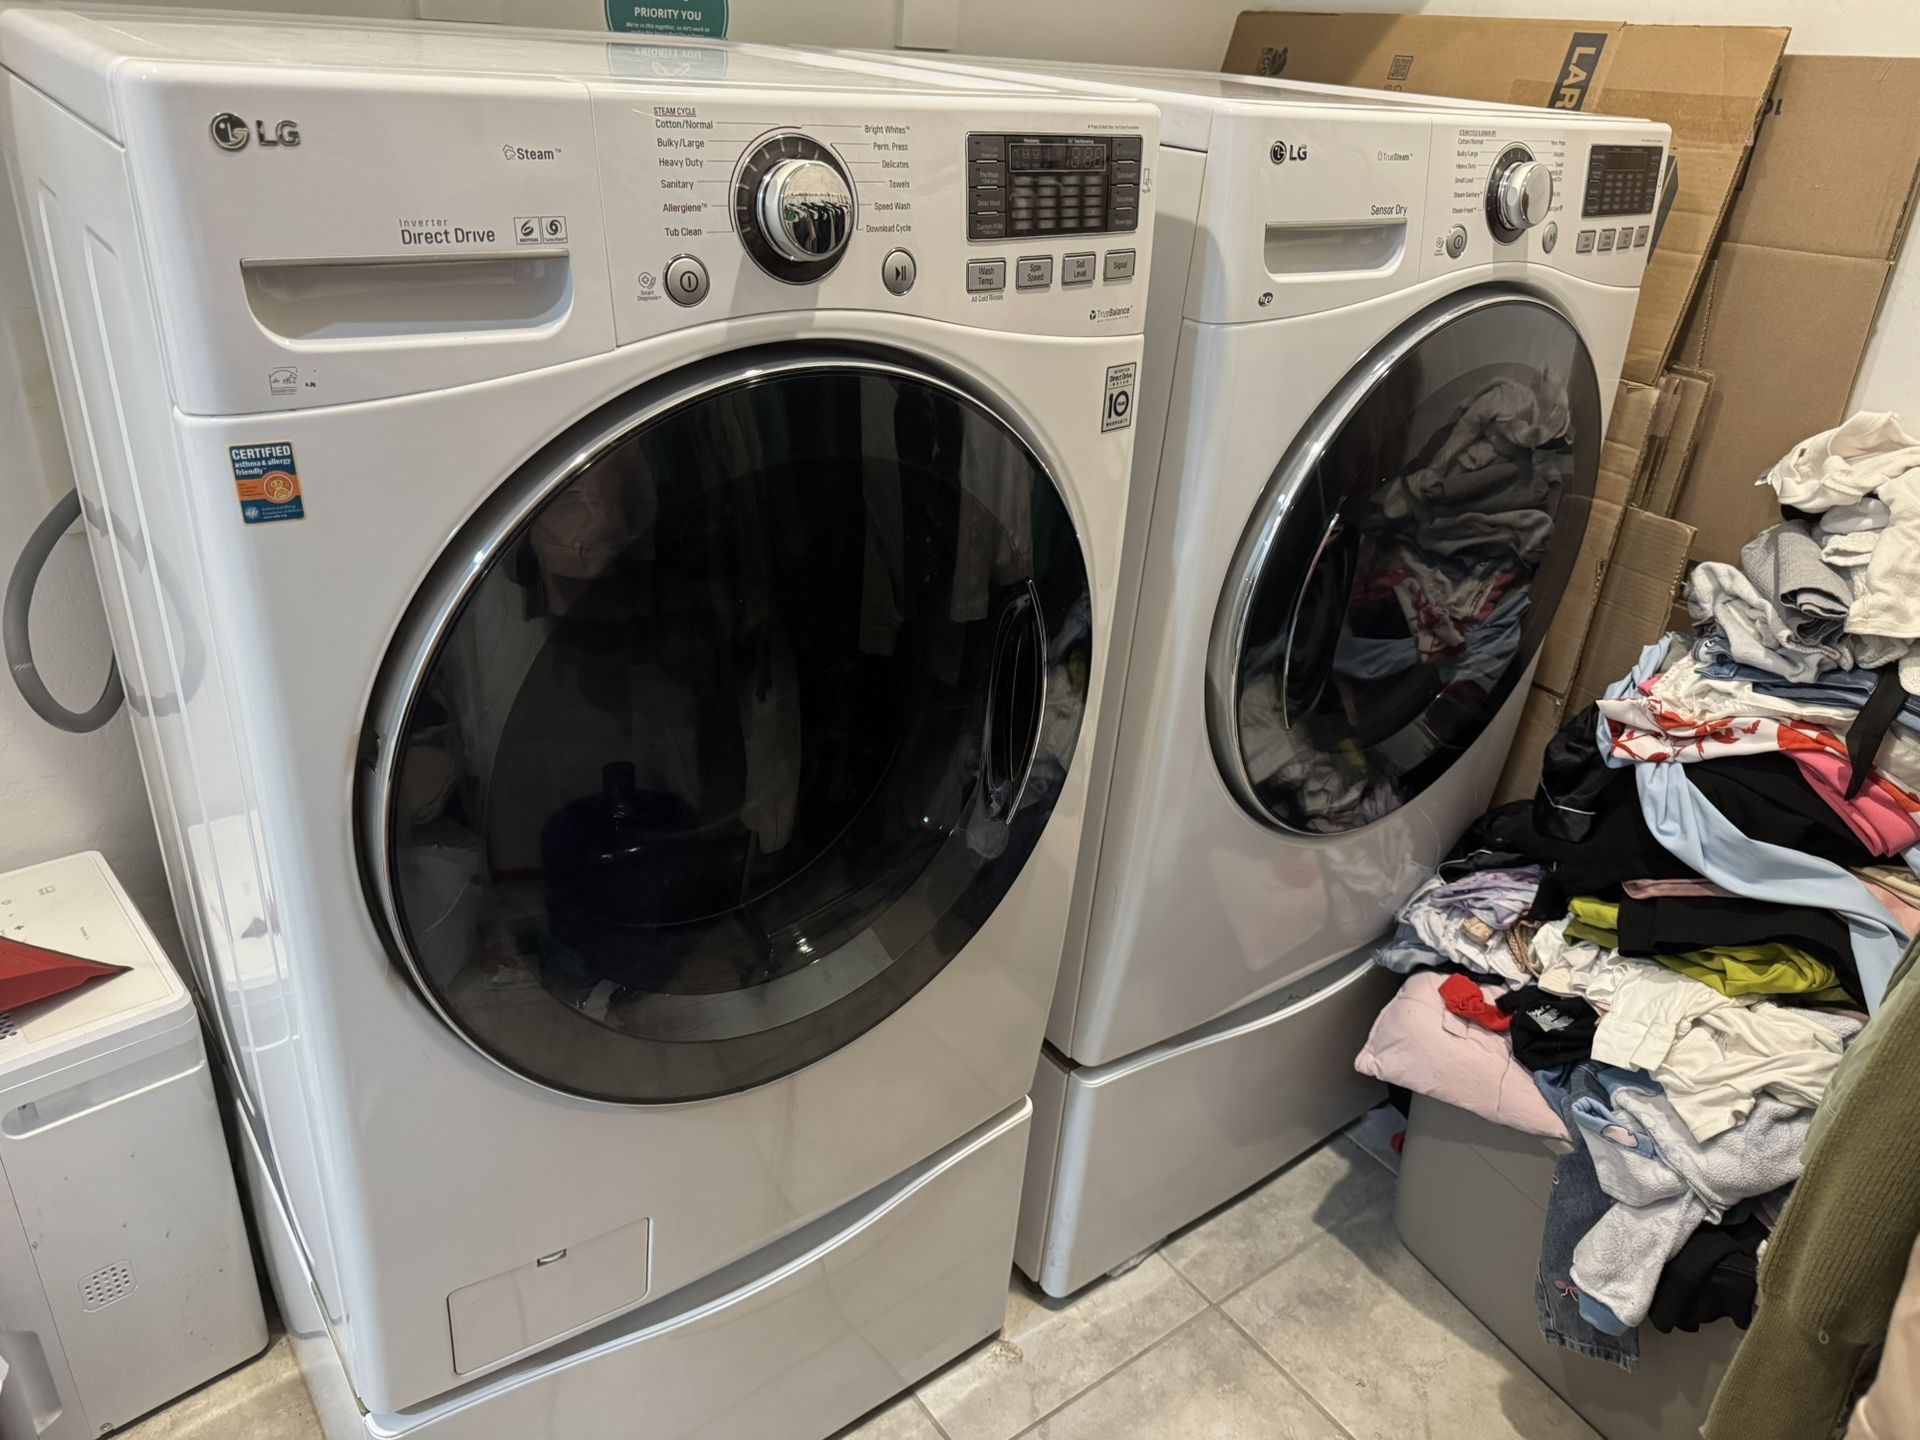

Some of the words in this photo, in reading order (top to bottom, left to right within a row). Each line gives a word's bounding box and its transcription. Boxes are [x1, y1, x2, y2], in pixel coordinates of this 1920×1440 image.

[634, 6, 679, 19] PRIORITY
[681, 10, 702, 21] YOU
[653, 107, 675, 116] STEAM
[677, 107, 696, 116] CYCLE
[655, 119, 714, 130] Cotton/Normal
[864, 124, 884, 135] Bright
[256, 119, 301, 147] LG
[657, 138, 705, 150] Bulky/Large
[892, 142, 908, 152] Press
[1289, 144, 1308, 161] LG
[659, 158, 684, 168] Heavy
[685, 158, 704, 168] Duty
[882, 160, 910, 169] Delicates
[660, 180, 694, 190] Sanitary
[888, 180, 910, 189] Towels
[874, 202, 894, 212] Speed
[894, 202, 911, 210] Wash
[1370, 204, 1394, 216] Sensor
[1396, 204, 1408, 216] Dry
[398, 218, 448, 228] Inverter
[664, 227, 679, 237] Tub
[681, 226, 702, 237] Clean
[866, 224, 895, 233] Download
[896, 224, 912, 234] Cycle
[401, 229, 452, 246] Direct
[454, 228, 496, 243] Drive
[1030, 263, 1042, 273] Spin
[1076, 260, 1085, 268] Soil
[1113, 261, 1128, 270] Signal
[978, 266, 994, 276] Wash
[1074, 269, 1087, 278] Level
[1027, 273, 1044, 282] Speed
[978, 294, 988, 302] Cold
[1108, 390, 1129, 419] 10
[232, 446, 291, 460] CERTIFIED
[234, 459, 261, 468] asthma
[268, 458, 292, 466] allergy
